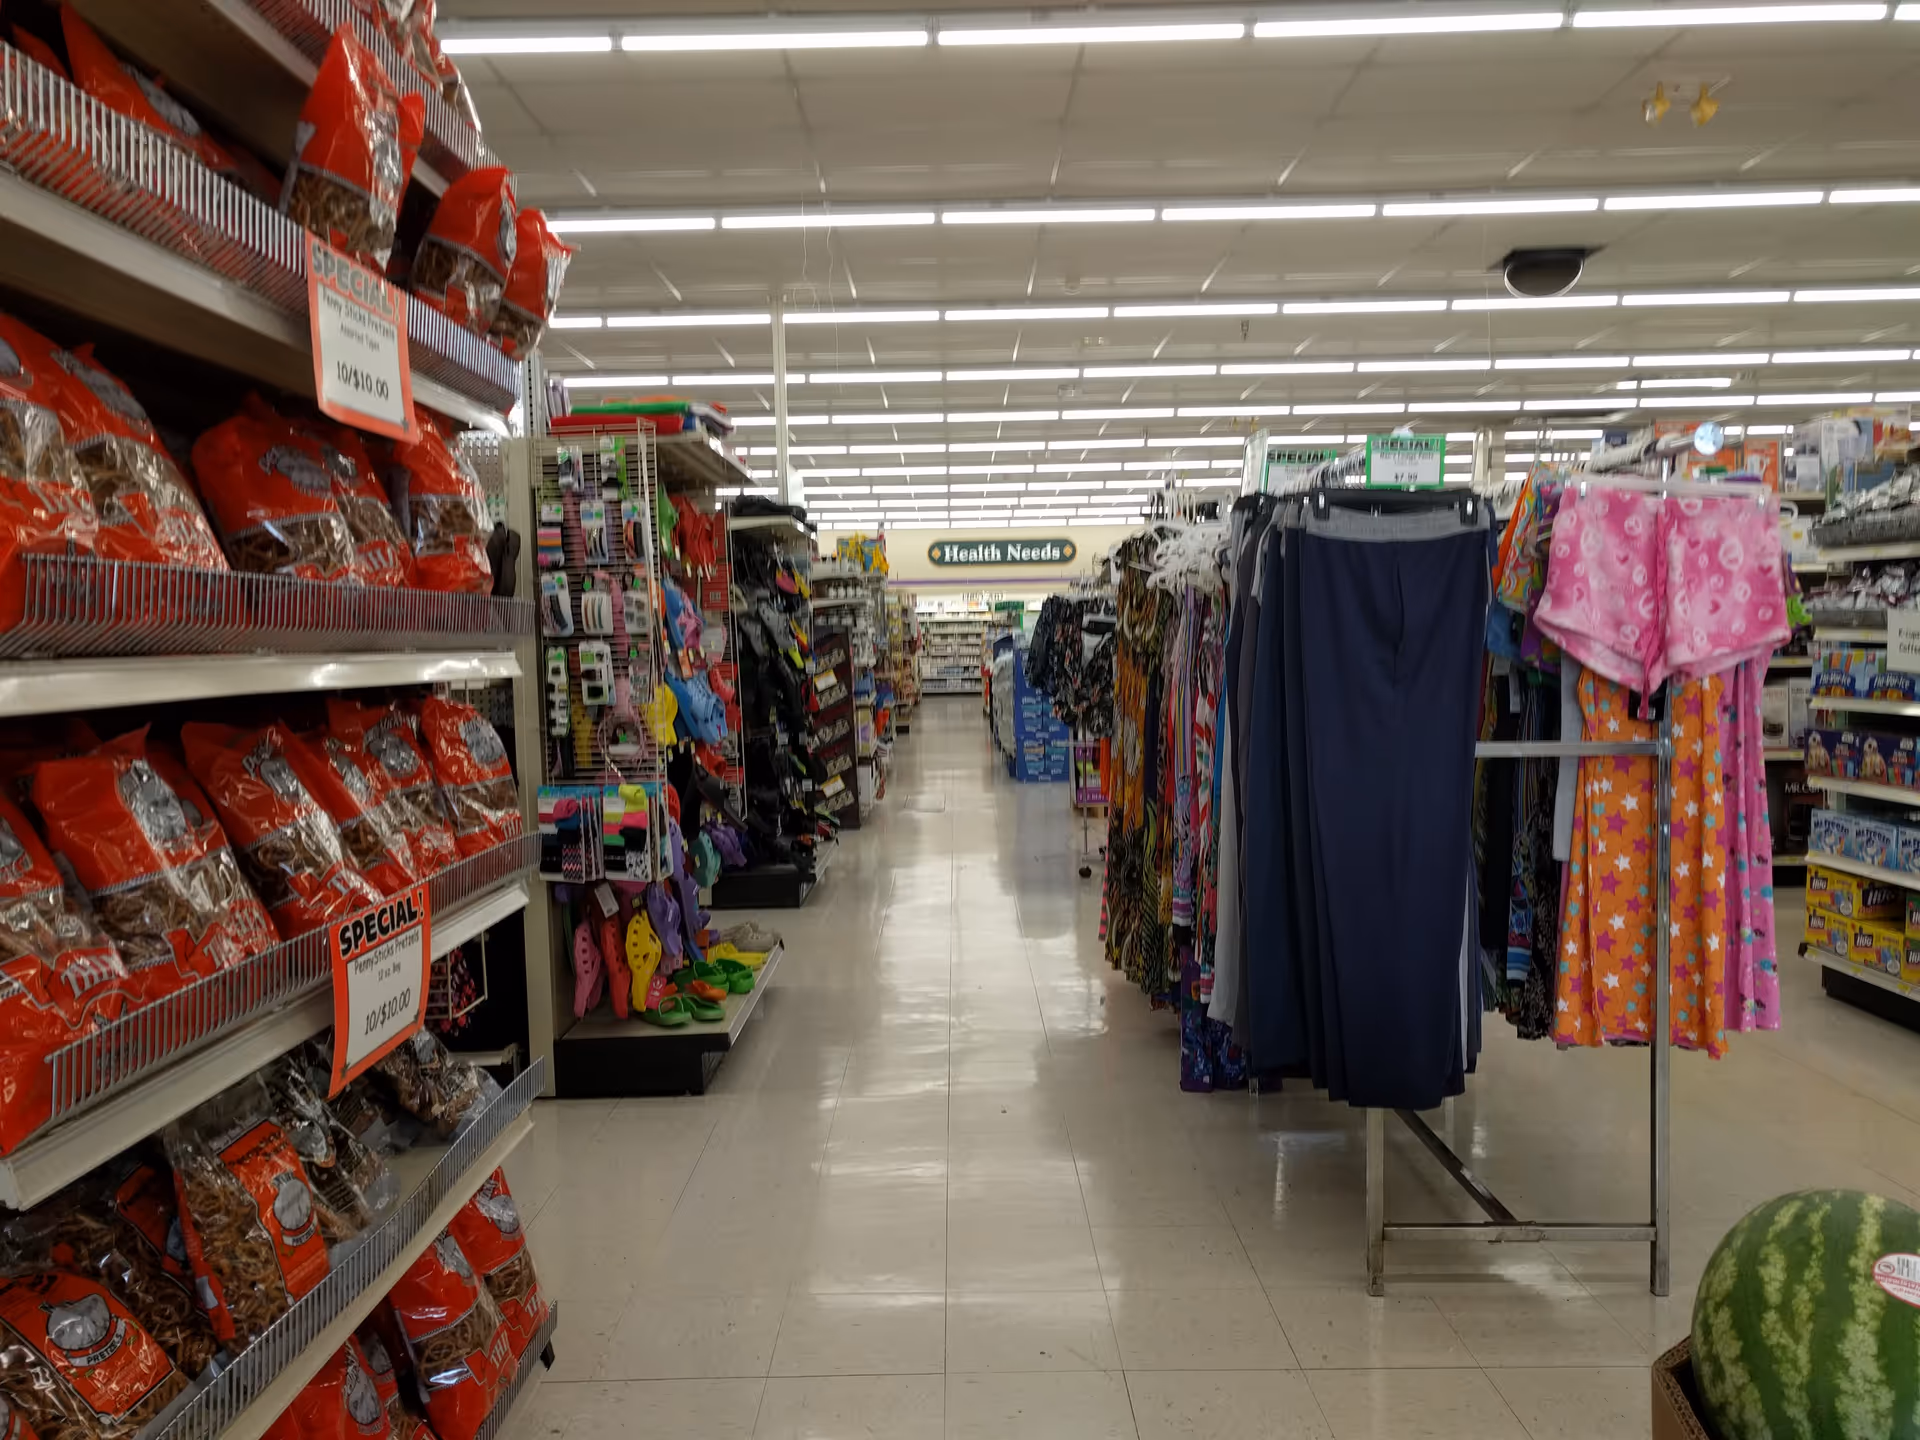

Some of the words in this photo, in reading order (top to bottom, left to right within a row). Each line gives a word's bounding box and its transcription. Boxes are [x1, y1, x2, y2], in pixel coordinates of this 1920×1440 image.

[311, 240, 400, 322] SPECIAL!
[322, 287, 342, 317] Penny
[344, 300, 366, 327] Sticks
[367, 314, 395, 343] Pretzels
[336, 360, 389, 400] 10/$10.00
[1372, 438, 1440, 451] SPECIAL!
[943, 543, 1001, 563] Health
[1006, 542, 1061, 562] Needs
[339, 891, 424, 958] SPECIAL!
[354, 957, 374, 976] Penny
[374, 943, 394, 965] Sticks
[395, 929, 419, 954] Pretzels
[365, 987, 411, 1036] 10/$10.00
